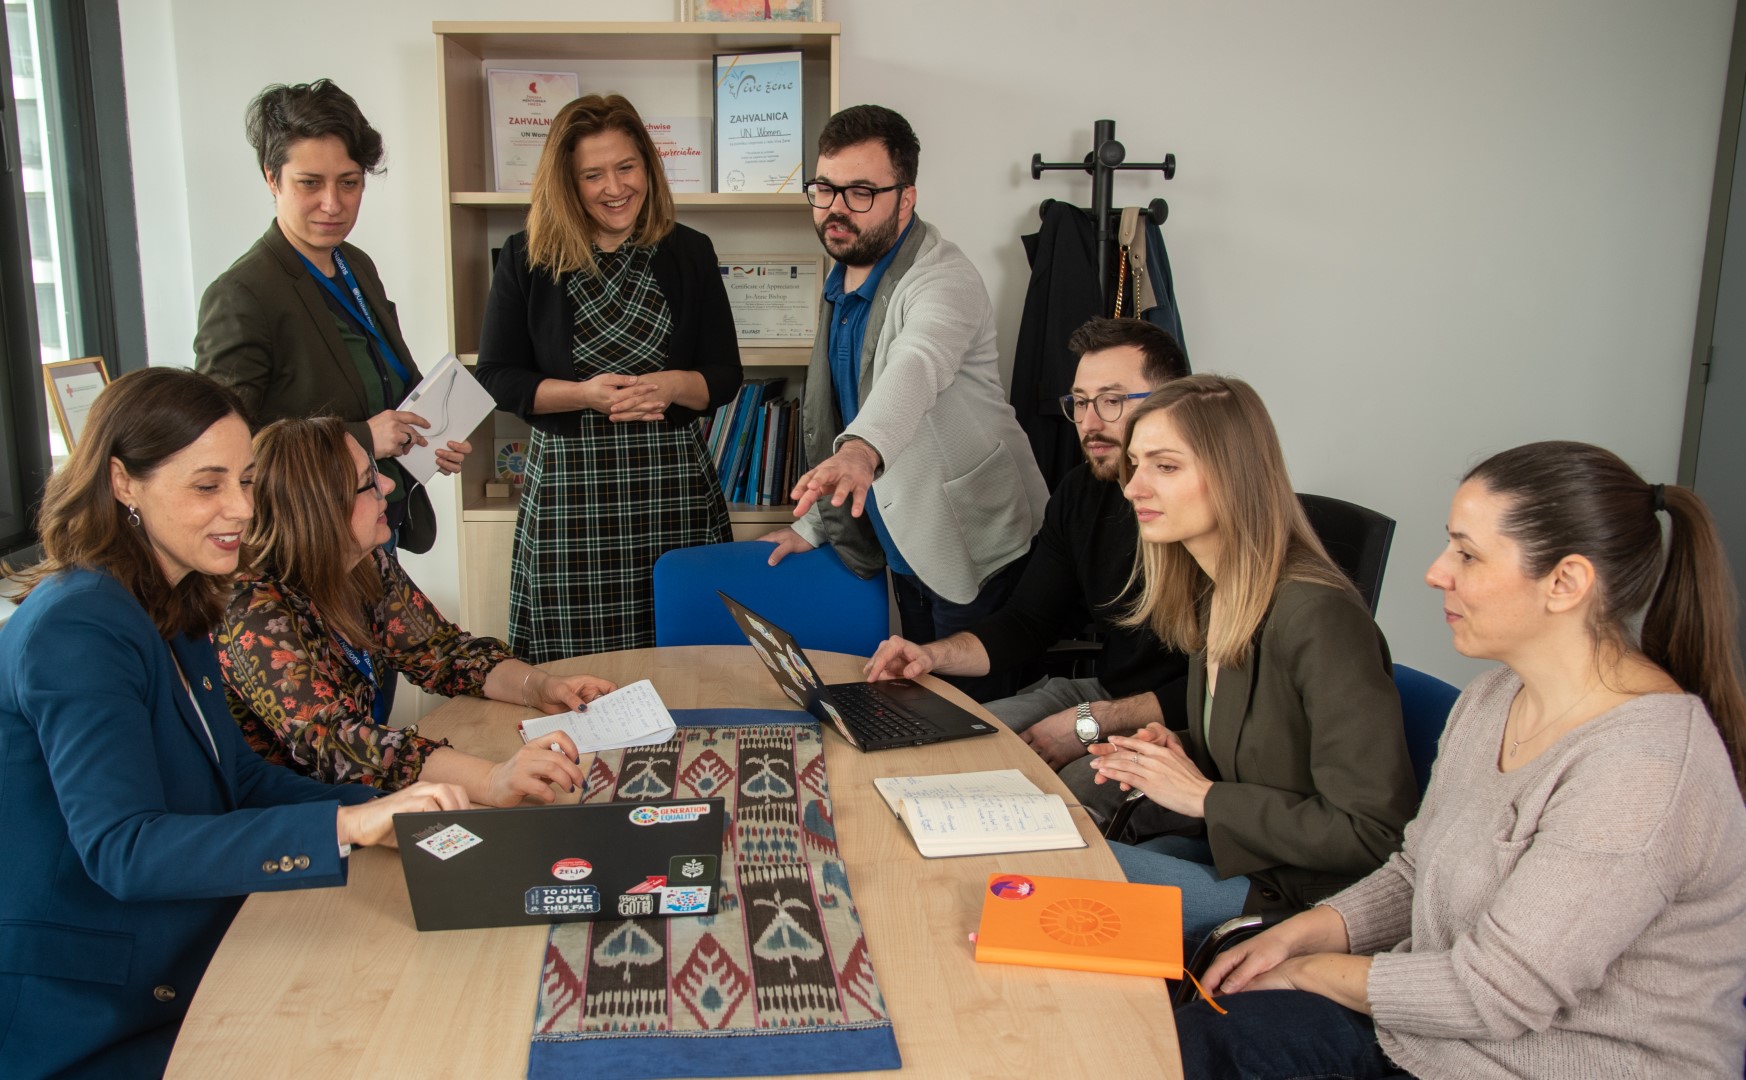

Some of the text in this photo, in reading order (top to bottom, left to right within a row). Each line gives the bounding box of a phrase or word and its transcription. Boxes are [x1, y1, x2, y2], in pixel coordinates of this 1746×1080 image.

[508, 116, 554, 126] ZAHVALNI
[729, 112, 789, 124] ZAHVALNICA
[740, 127, 782, 138] UN Women
[334, 250, 349, 276] Nations
[340, 641, 361, 666] Nations
[660, 806, 708, 815] GENERATION
[660, 813, 697, 821] EQUALITY
[543, 894, 593, 904] COME
